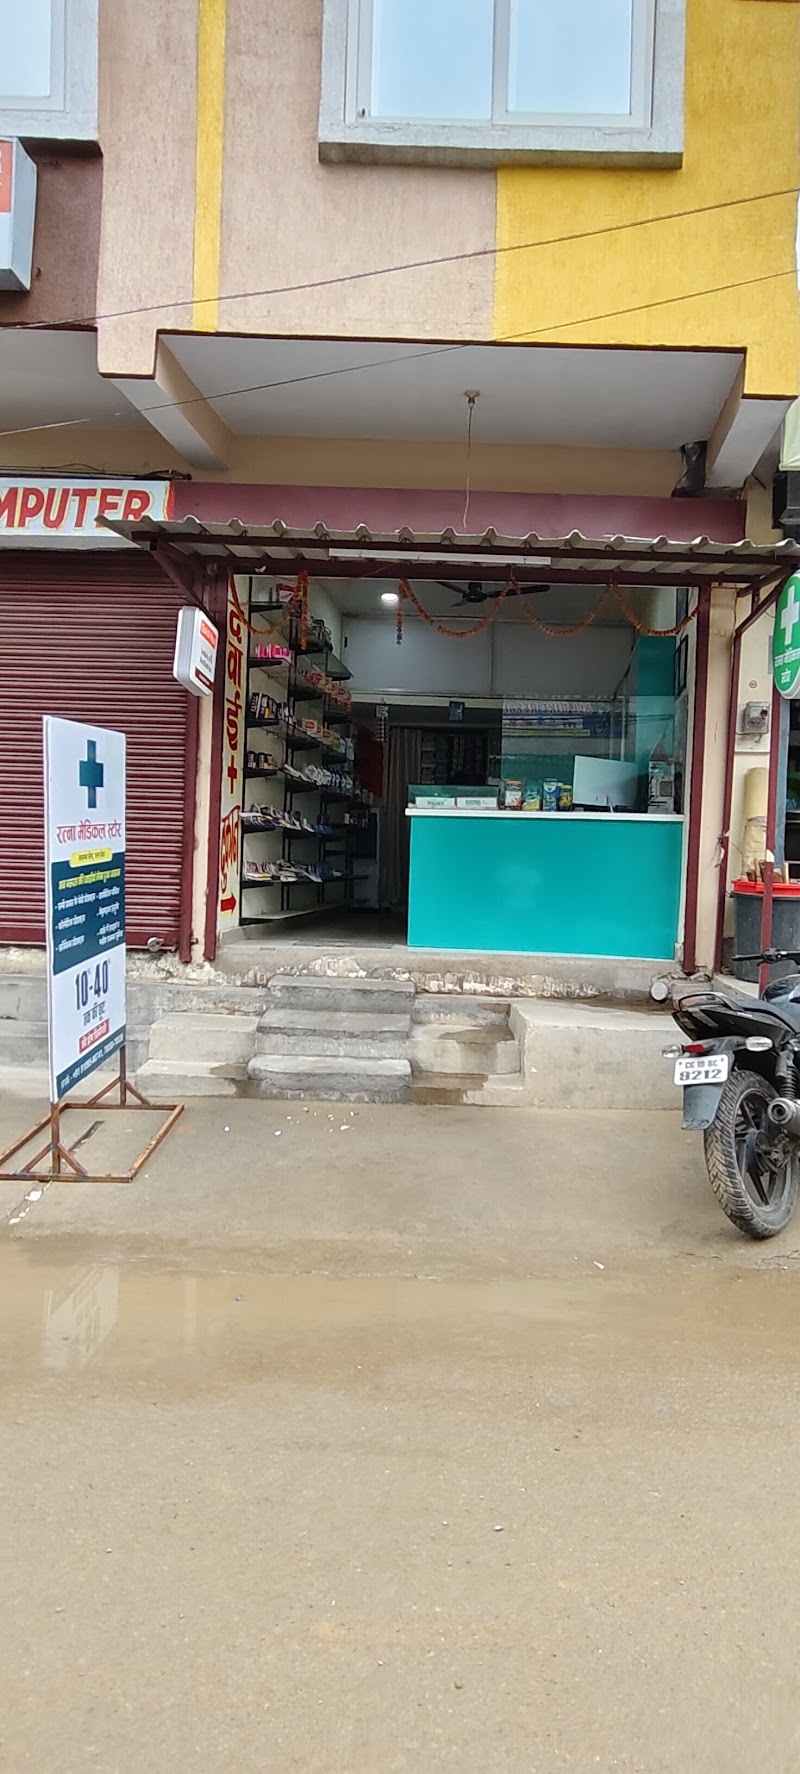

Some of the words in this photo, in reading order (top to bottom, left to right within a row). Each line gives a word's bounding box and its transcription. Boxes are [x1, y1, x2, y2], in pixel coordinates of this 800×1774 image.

[0, 487, 150, 529] MPUTER
[56, 826, 76, 844] रत्ना
[78, 819, 106, 840] मेडिकल
[107, 819, 122, 838] स्टोर
[679, 1069, 722, 1081] 9212
